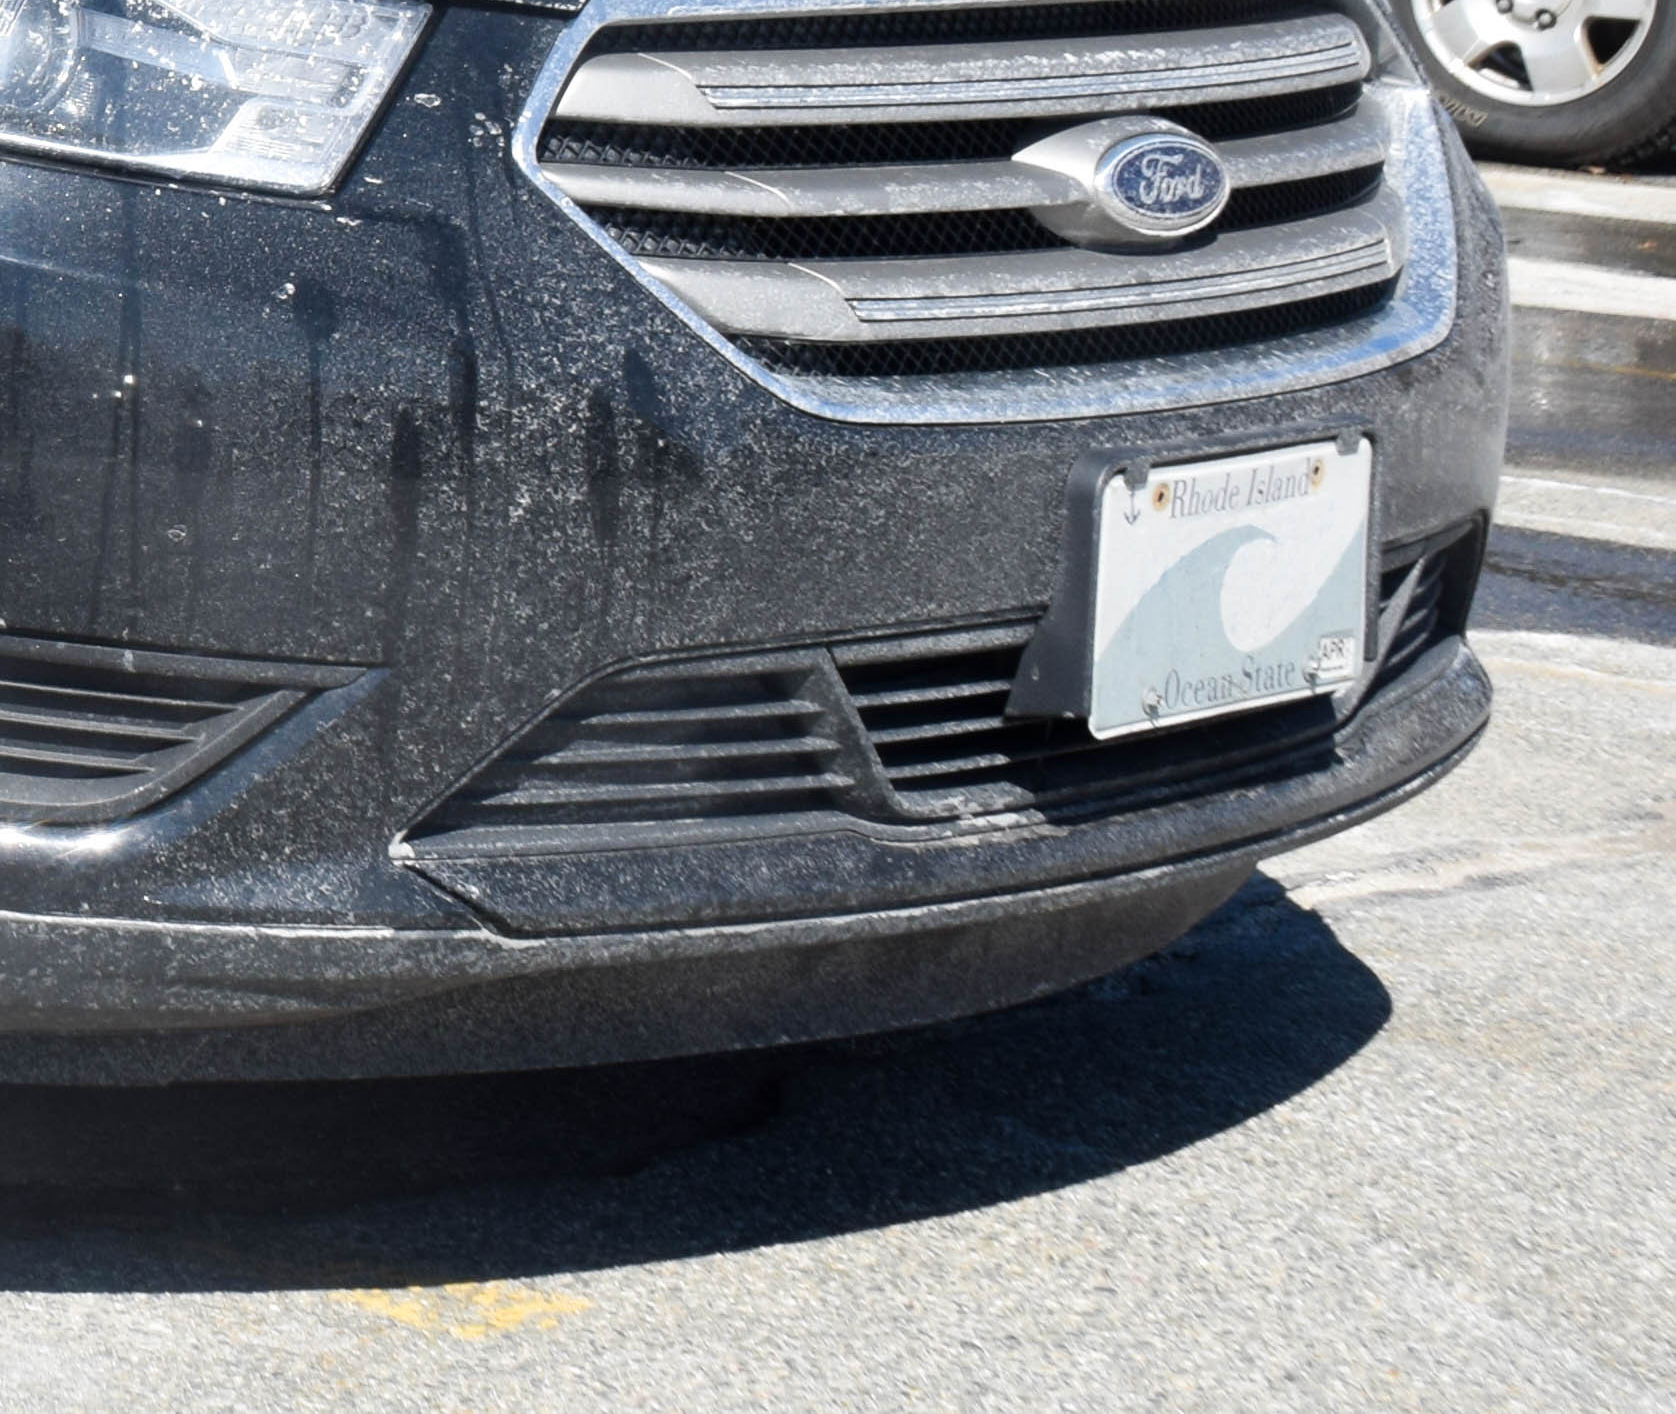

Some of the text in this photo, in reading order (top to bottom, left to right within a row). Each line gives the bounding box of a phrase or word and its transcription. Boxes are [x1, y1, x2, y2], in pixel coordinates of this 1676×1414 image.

[1139, 154, 1205, 204] Ford
[1170, 457, 1312, 518] Rhode Island
[1164, 655, 1296, 709] Ocean State
